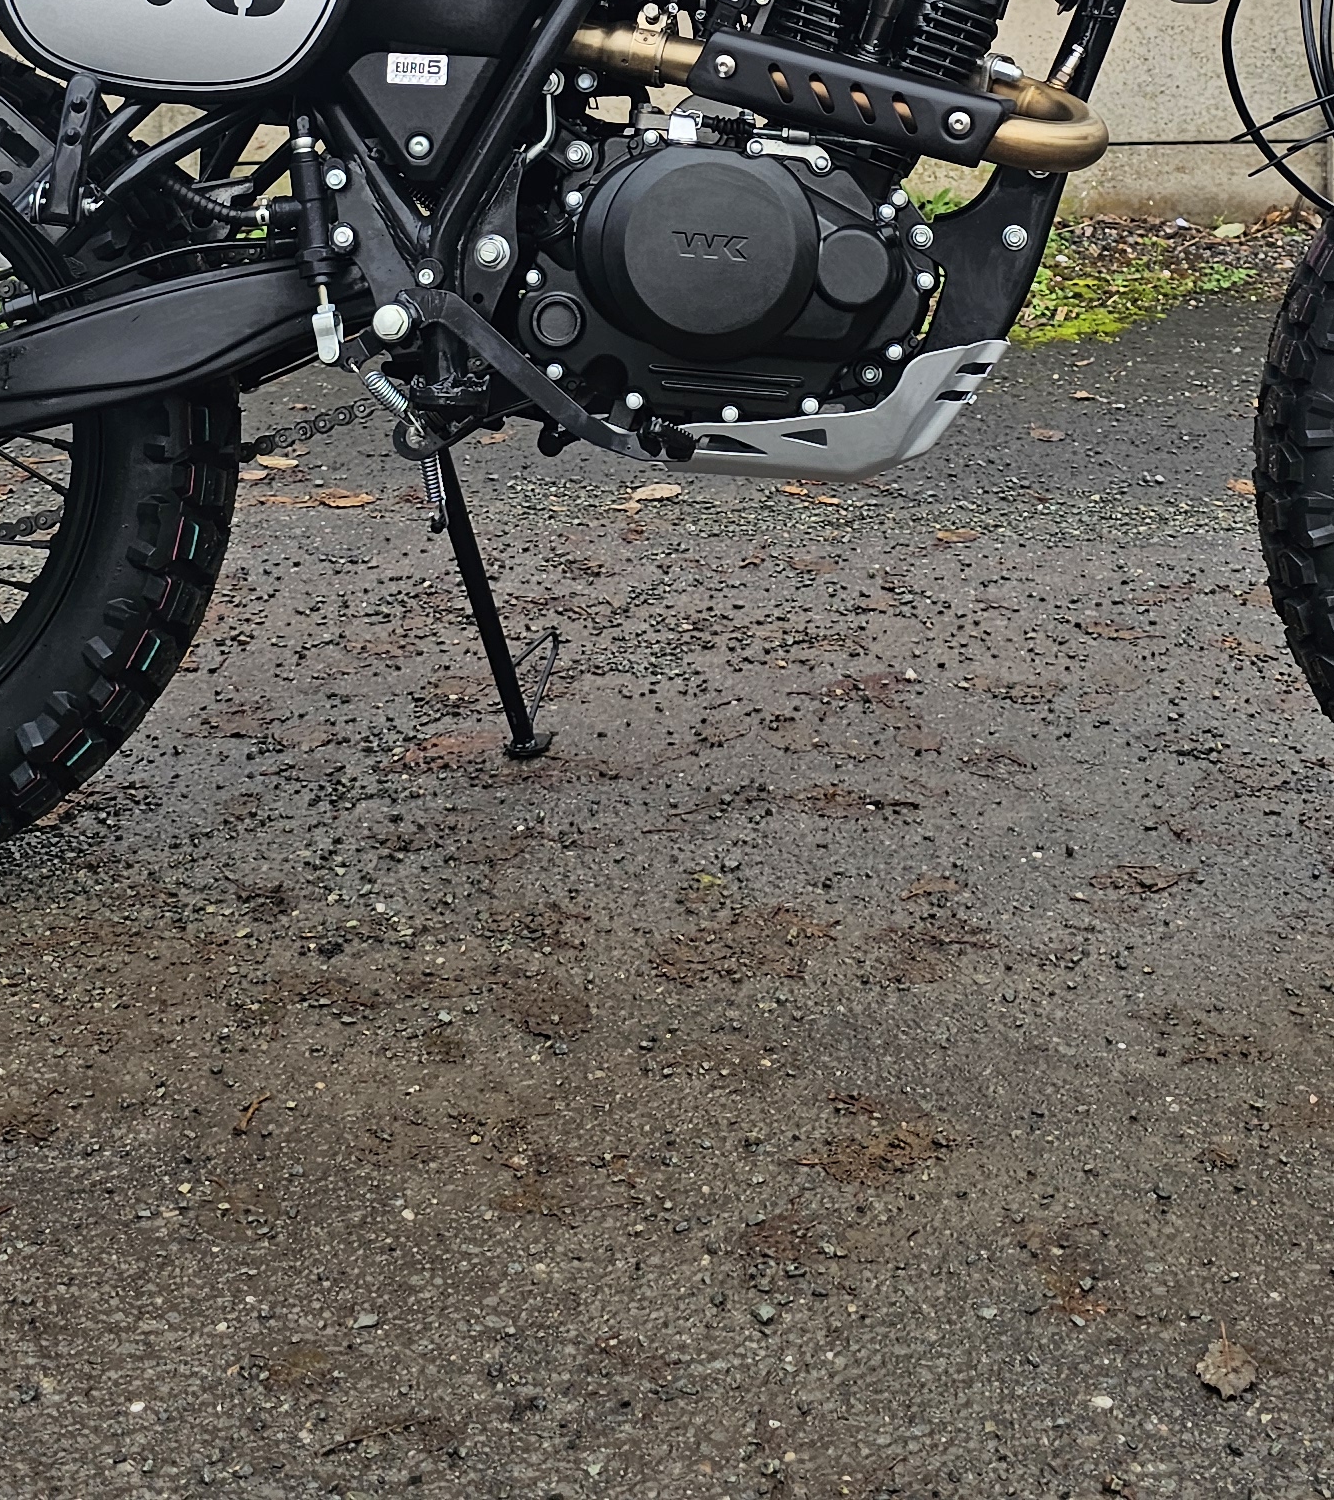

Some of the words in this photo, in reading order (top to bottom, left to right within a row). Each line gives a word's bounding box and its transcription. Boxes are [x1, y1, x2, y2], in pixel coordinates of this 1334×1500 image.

[395, 61, 425, 74] EURO
[427, 59, 442, 75] 5
[671, 230, 749, 262] WK
